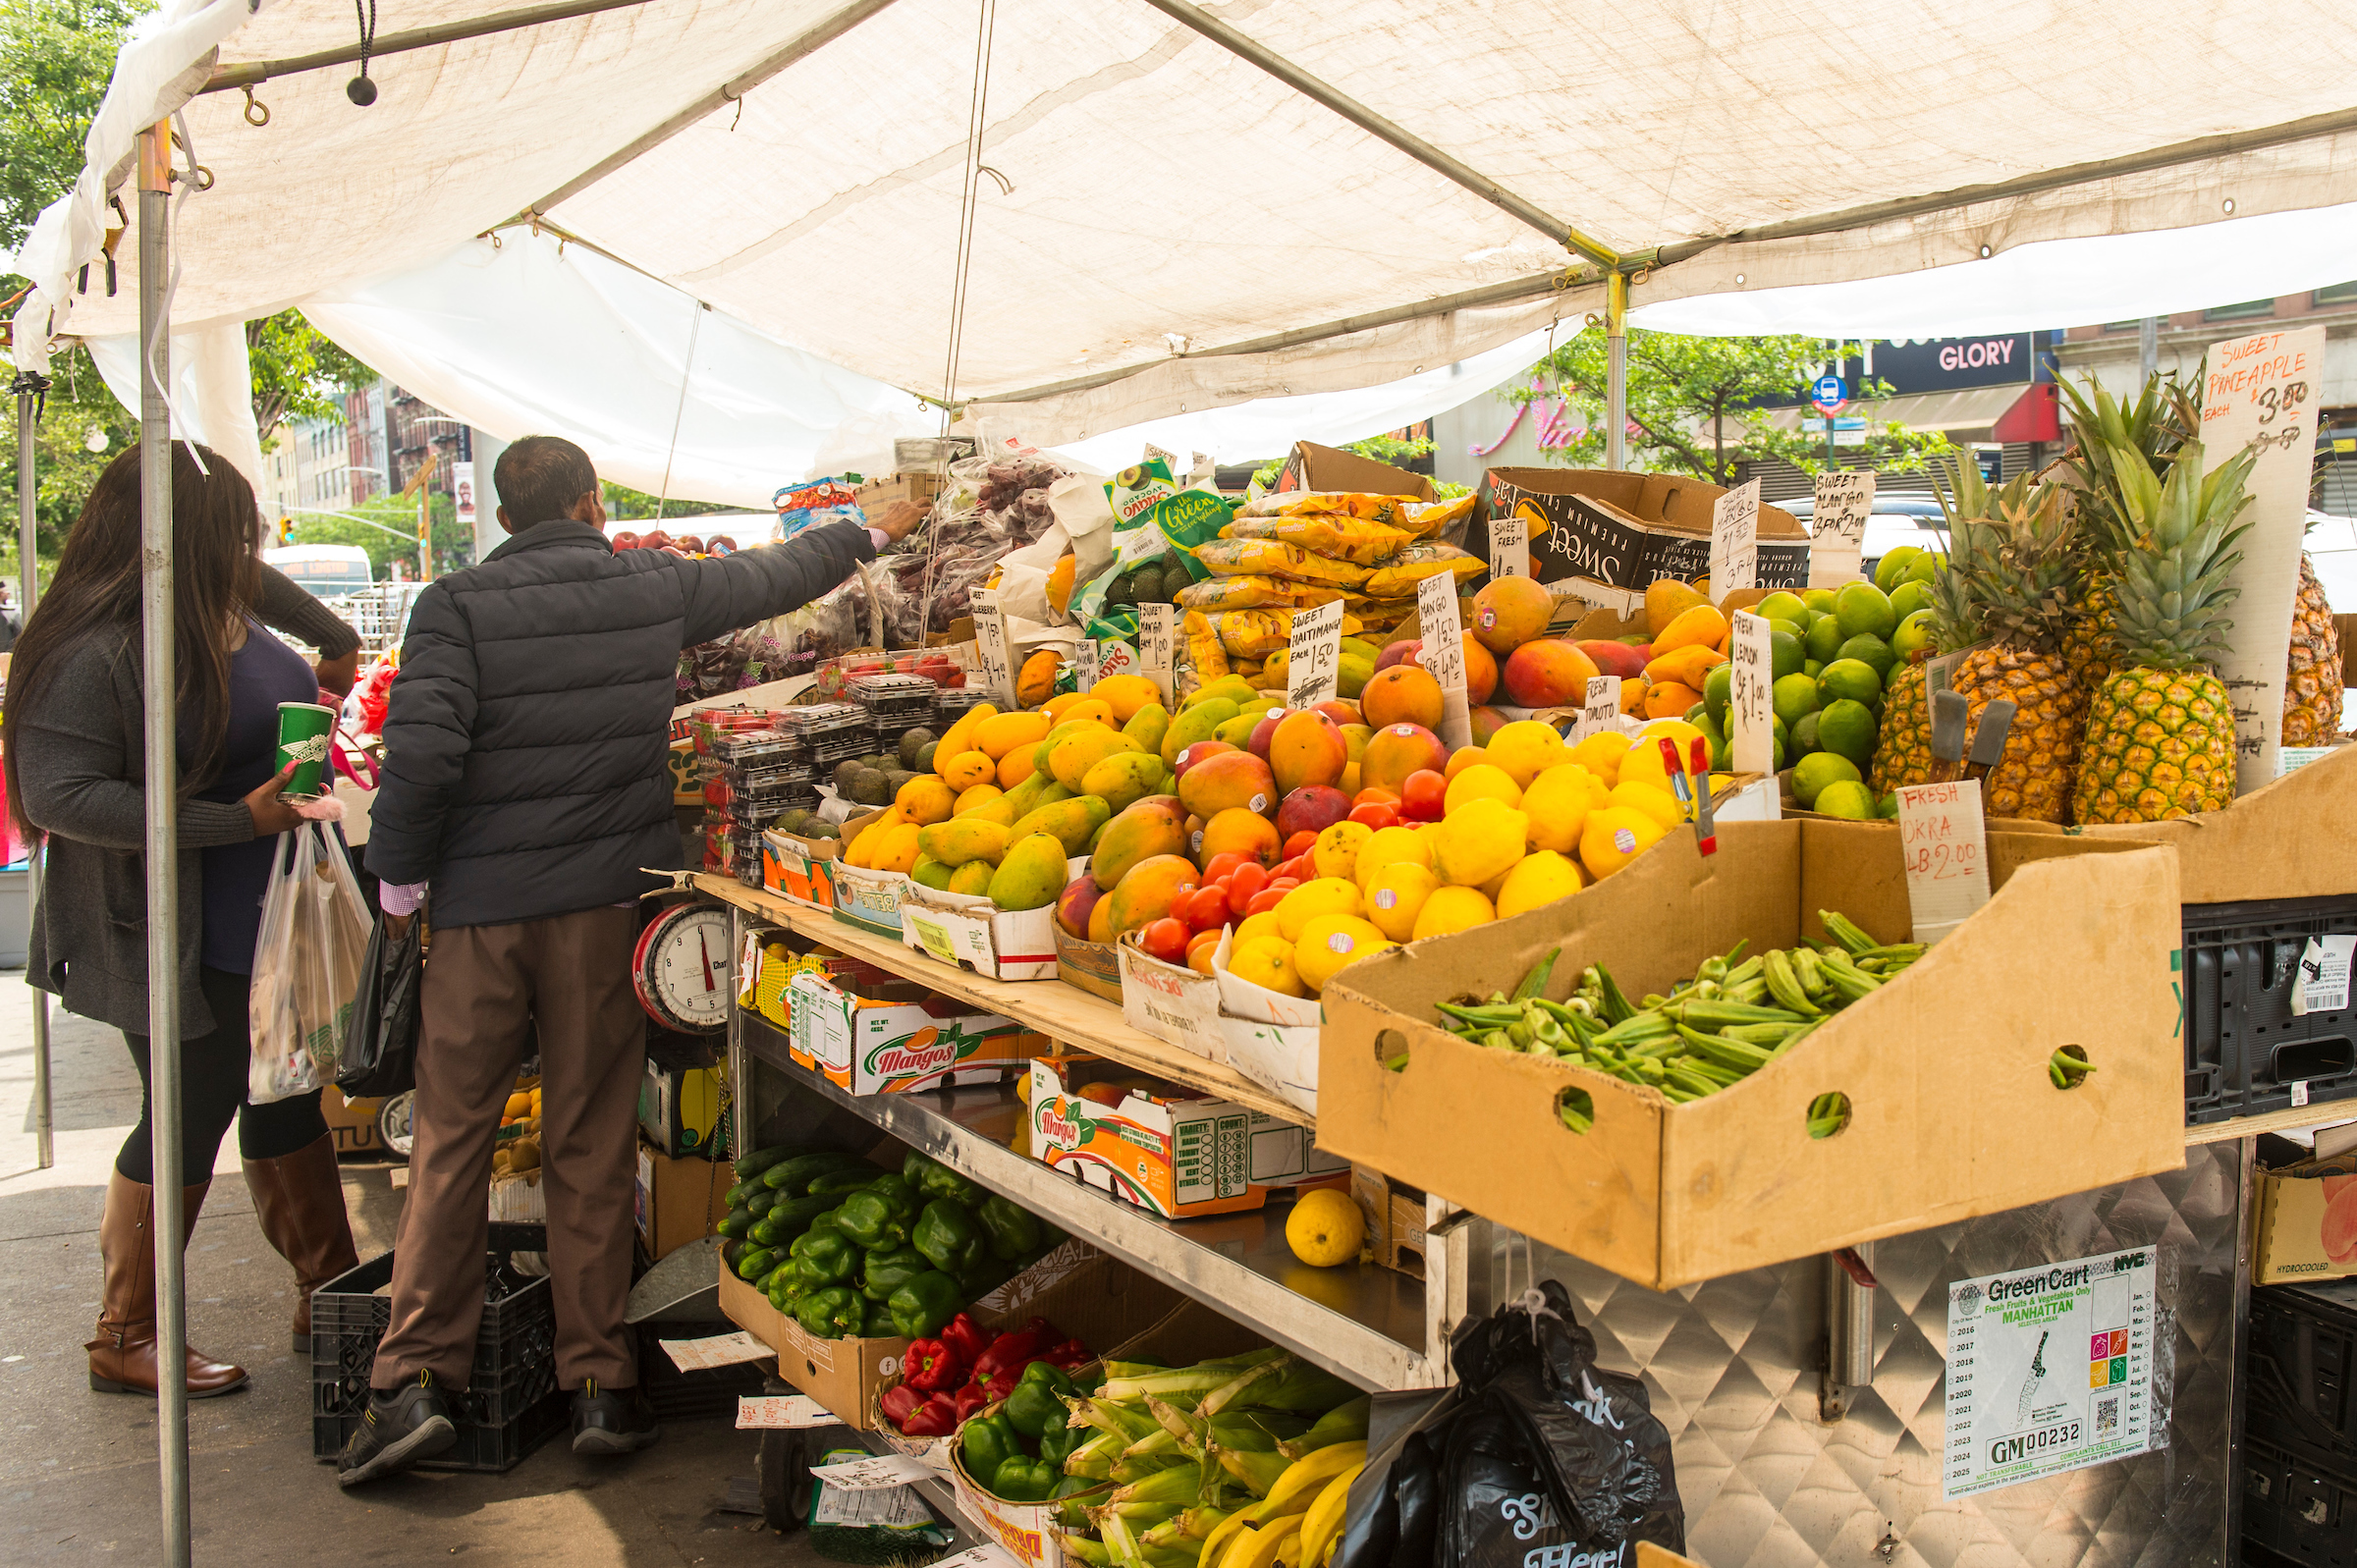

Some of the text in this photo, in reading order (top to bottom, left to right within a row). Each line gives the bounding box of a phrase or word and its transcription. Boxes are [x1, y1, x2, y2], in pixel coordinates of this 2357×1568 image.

[1940, 339, 2014, 371] GLORY
[2221, 333, 2284, 368] SWEET
[2209, 352, 2306, 404] PINEAPPLE
[2204, 404, 2230, 422] EACH
[1147, 447, 1175, 464] SWEET
[1817, 474, 1862, 491] SWEET
[1122, 484, 1163, 507] AVOCADO
[1177, 495, 1194, 507] the
[1722, 481, 1753, 510] SWEET
[1816, 491, 1864, 510] MANGO
[1165, 497, 1216, 528] Green
[1186, 504, 1222, 528] everything!
[1715, 501, 1755, 533] MANGO
[1494, 519, 1526, 536] SWEET
[1565, 506, 1628, 552] PREMIUM
[1498, 534, 1524, 549] FRESH
[1548, 520, 1621, 585] Sweet
[308, 561, 350, 574] LIMITED
[1419, 575, 1444, 599] SWEET
[1142, 604, 1163, 616] SWEET
[1420, 596, 1447, 622] MANGO
[1291, 607, 1326, 629] SWEET
[1734, 614, 1754, 637] FRESH
[1140, 621, 1163, 635] MANGO
[1422, 622, 1434, 637] EACH
[1076, 640, 1090, 651] FRESH
[1735, 641, 1759, 666] LEMON
[1077, 652, 1095, 666] AVOCADO
[1290, 649, 1309, 664] EACH
[1442, 649, 1460, 687] 4.00
[1587, 677, 1609, 700] FRESH
[1903, 784, 1959, 810] FRESH
[1903, 815, 1952, 844] OKRA
[1933, 843, 1976, 880] 2.00
[856, 891, 896, 913] BELLE
[697, 925, 702, 935] 0
[677, 937, 683, 946] 9
[666, 957, 672, 967] 8
[670, 984, 675, 993] 7
[686, 998, 692, 1007] 6
[709, 1000, 715, 1009] 5
[1166, 1012, 1188, 1031] BUSHEL
[878, 1044, 955, 1074] Mangos
[1042, 1111, 1076, 1144] Mangos
[1179, 1123, 1210, 1135] VARIETY:
[1220, 1118, 1245, 1130] COUNT:
[683, 1132, 695, 1142] 1/2
[1178, 1148, 1199, 1158] TOMMY
[1179, 1178, 1199, 1187] OTHERS
[2113, 1252, 2145, 1273] NYC
[2276, 1263, 2329, 1274] HYDROCOOLED
[1985, 1304, 2004, 1314] Fresh
[2006, 1299, 2026, 1310] Fruits
[2038, 1290, 2073, 1304] Vegetables
[2075, 1287, 2091, 1296] Only
[2002, 1299, 2073, 1324] MANHATTAN
[1956, 1326, 1975, 1336] 2016
[2017, 1318, 2041, 1327] SELECTED
[1956, 1342, 1974, 1351] 2017
[1955, 1358, 1974, 1368] 2018
[1954, 1374, 1973, 1383] 2019
[1954, 1389, 1972, 1399] 2020
[1954, 1405, 1972, 1415] 2021
[1953, 1421, 1972, 1432] 2022
[1953, 1436, 1971, 1446] 2023
[1952, 1452, 1971, 1462] 2024
[2060, 1446, 2095, 1461] COMPLAINTS
[1952, 1468, 1970, 1479] 2025
[1979, 1481, 1995, 1489] expires
[2009, 1475, 2019, 1484] year
[2047, 1463, 2066, 1473] midnight
[2111, 1448, 2125, 1457] month
[2126, 1442, 2144, 1454] punched.
[1990, 1461, 2033, 1478] TRANSFERABLE
[980, 1504, 1042, 1560] DRAGON
